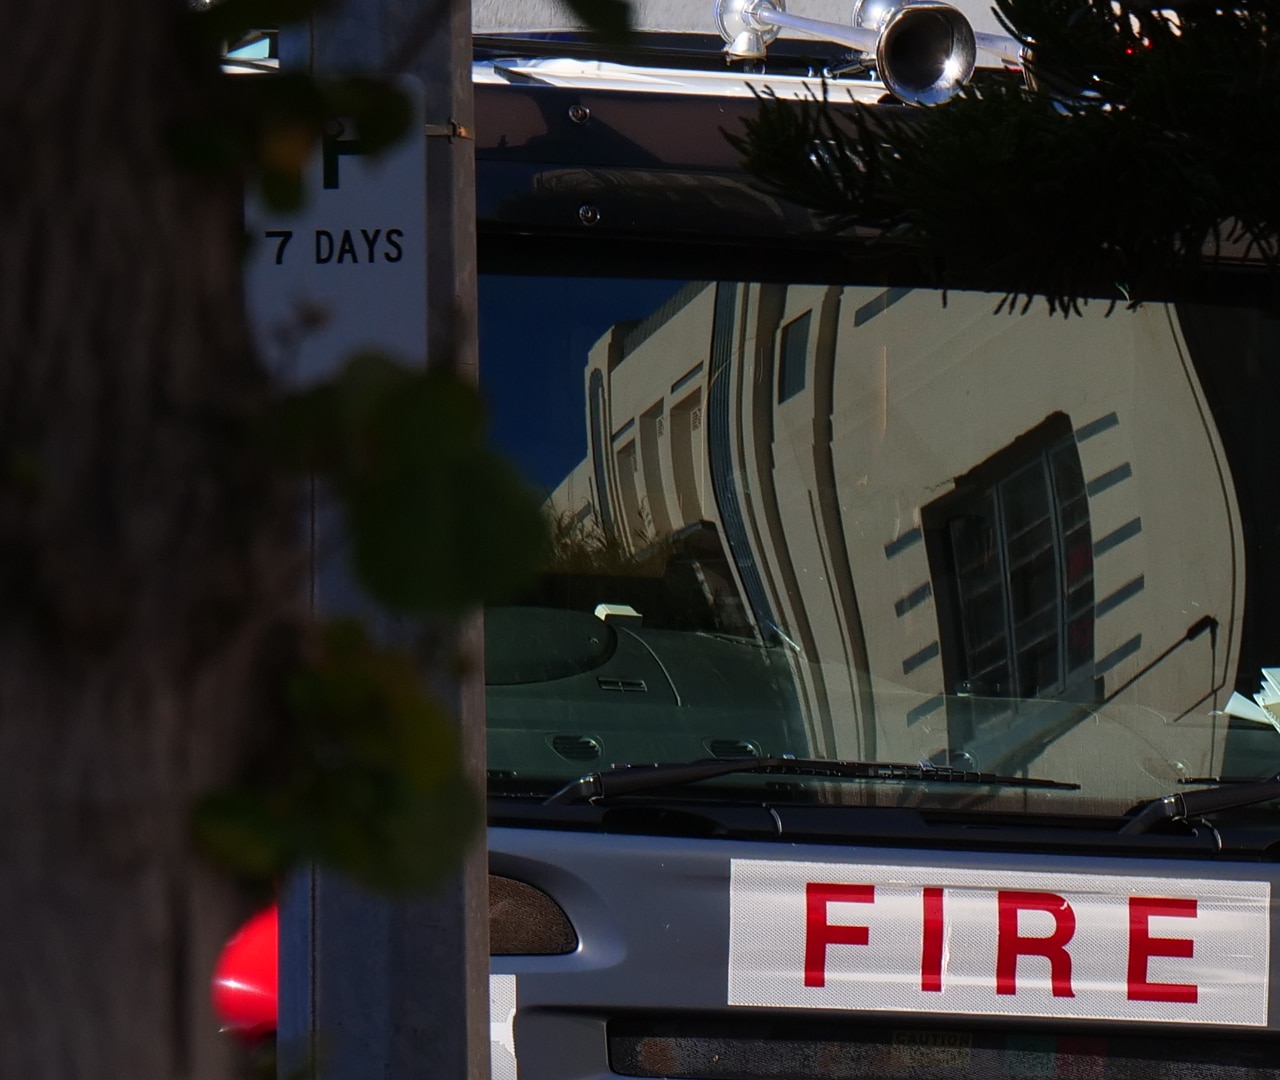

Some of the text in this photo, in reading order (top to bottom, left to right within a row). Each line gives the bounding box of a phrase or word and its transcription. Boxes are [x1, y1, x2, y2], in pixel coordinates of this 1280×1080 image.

[264, 228, 404, 265] 7 DAYS
[803, 882, 1199, 1004] FIRE
[895, 1031, 971, 1048] CAUTION
